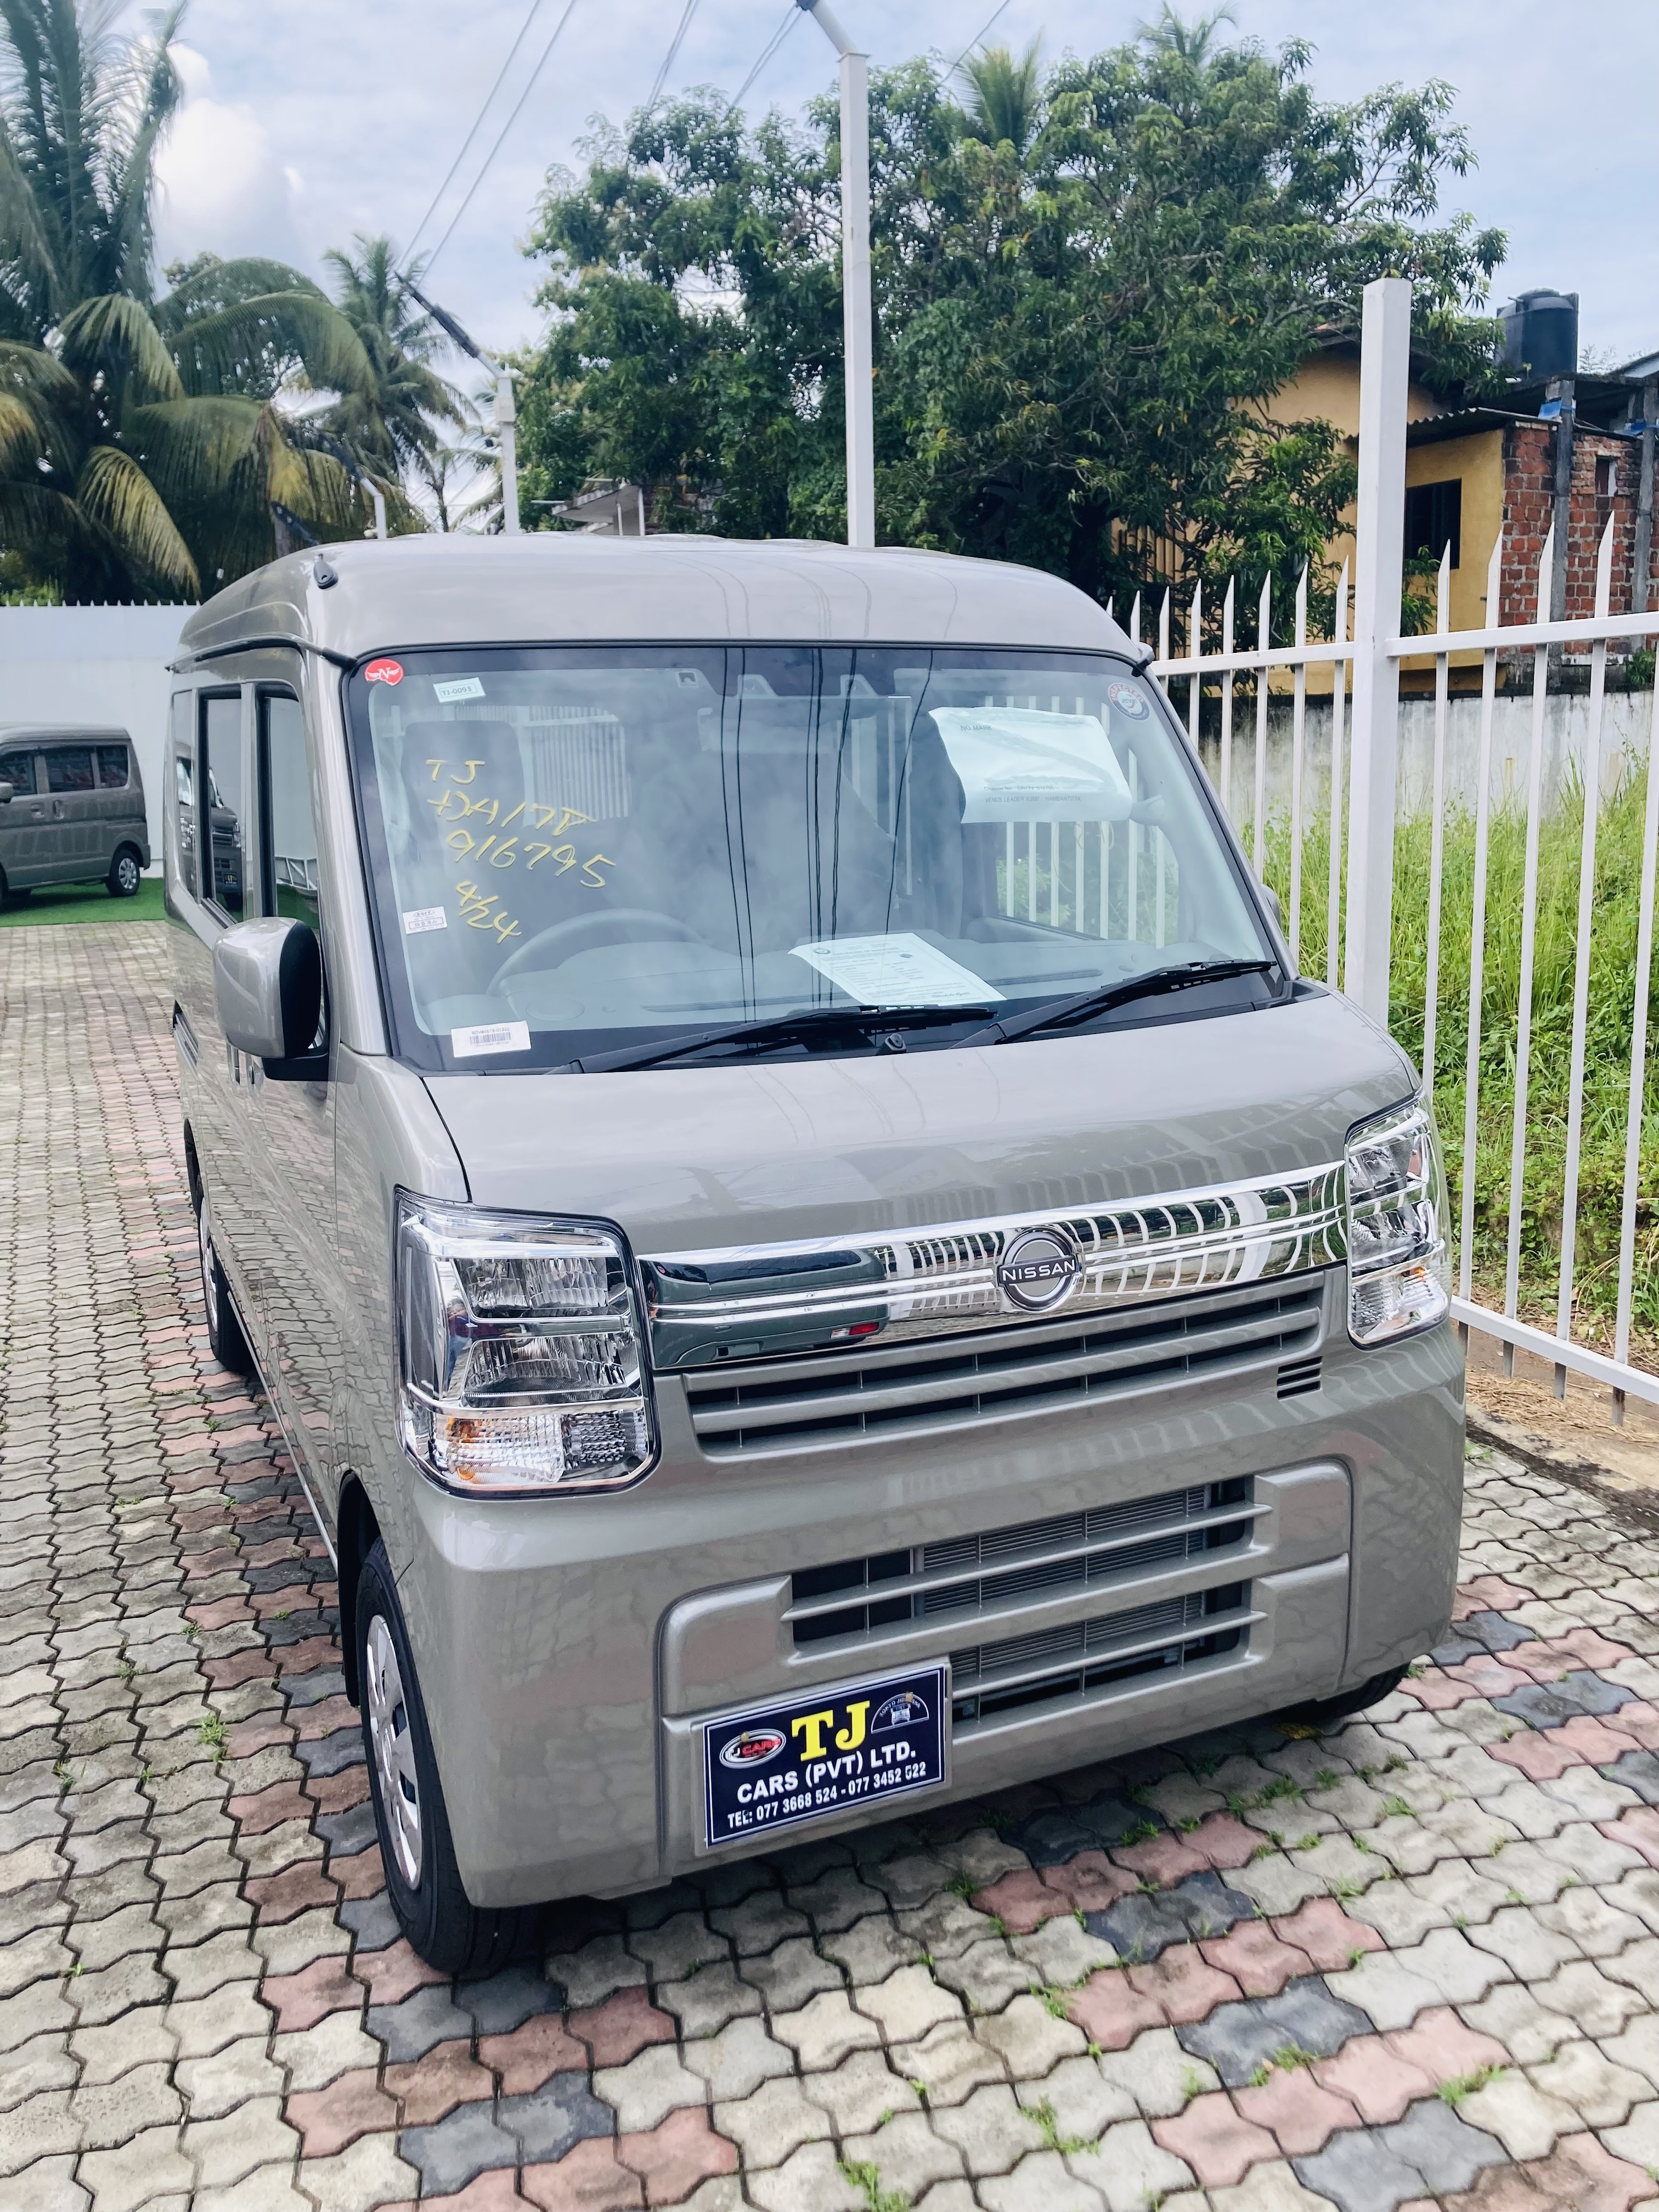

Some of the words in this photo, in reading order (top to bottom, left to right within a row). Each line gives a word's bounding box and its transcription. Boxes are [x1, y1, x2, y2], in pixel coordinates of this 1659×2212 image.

[441, 686, 472, 696] TJ-0093
[1109, 684, 1144, 703] INSPECTED
[446, 829, 617, 888] 916795
[1001, 1259, 1076, 1282] NISSAN
[896, 1697, 921, 1709] JIDSHA
[791, 1700, 871, 1762] TJ
[737, 1770, 799, 1804] CARS
[805, 1750, 864, 1788] (PVT)
[870, 1740, 917, 1769] LTD.
[727, 1809, 753, 1829] TEL:
[756, 1801, 779, 1821] 077
[782, 1792, 812, 1814] 3668
[815, 1785, 838, 1805] 524
[848, 1775, 870, 1796] 077
[873, 1767, 902, 1789] 3452
[905, 1760, 927, 1781] 522
